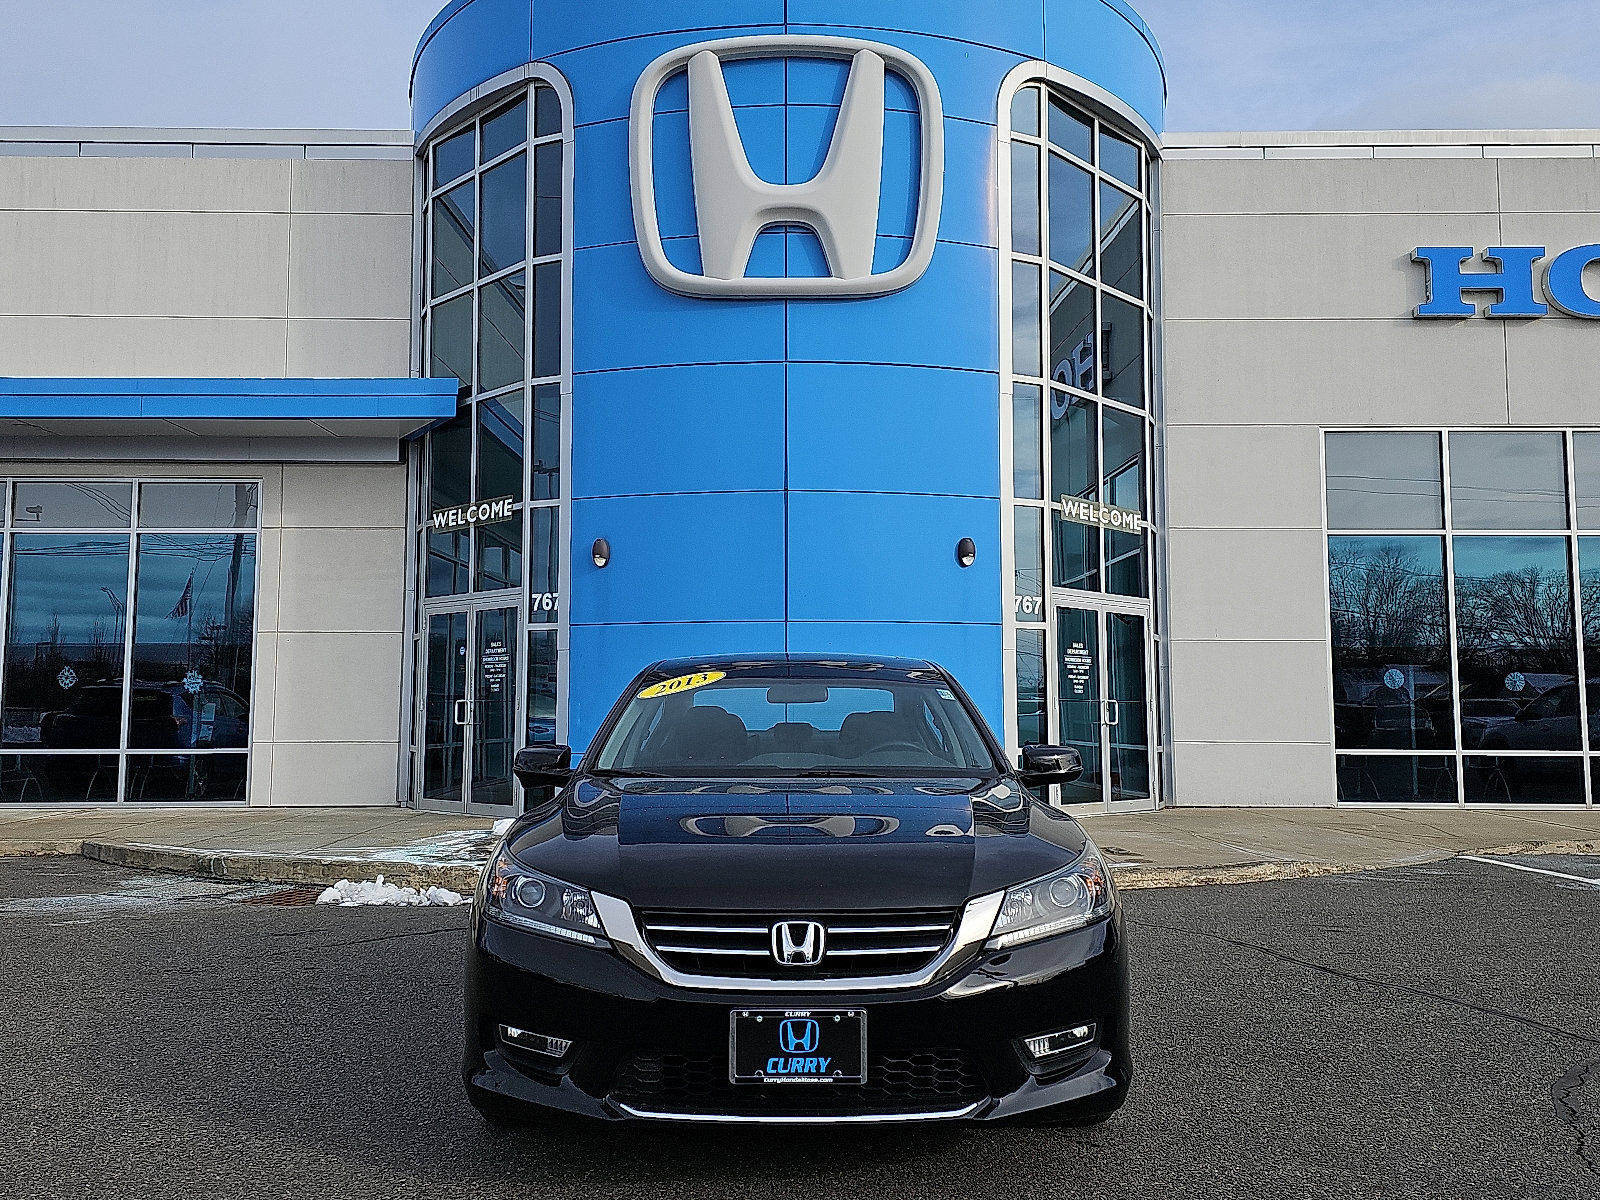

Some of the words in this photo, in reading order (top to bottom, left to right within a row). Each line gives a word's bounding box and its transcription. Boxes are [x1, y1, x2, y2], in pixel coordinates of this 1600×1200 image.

[432, 499, 513, 529] WELCOME
[1061, 498, 1142, 531] WELCOME
[531, 593, 559, 612] 767
[1014, 595, 1043, 615] 767
[655, 673, 709, 695] 2013
[766, 1057, 832, 1074] CURRY
